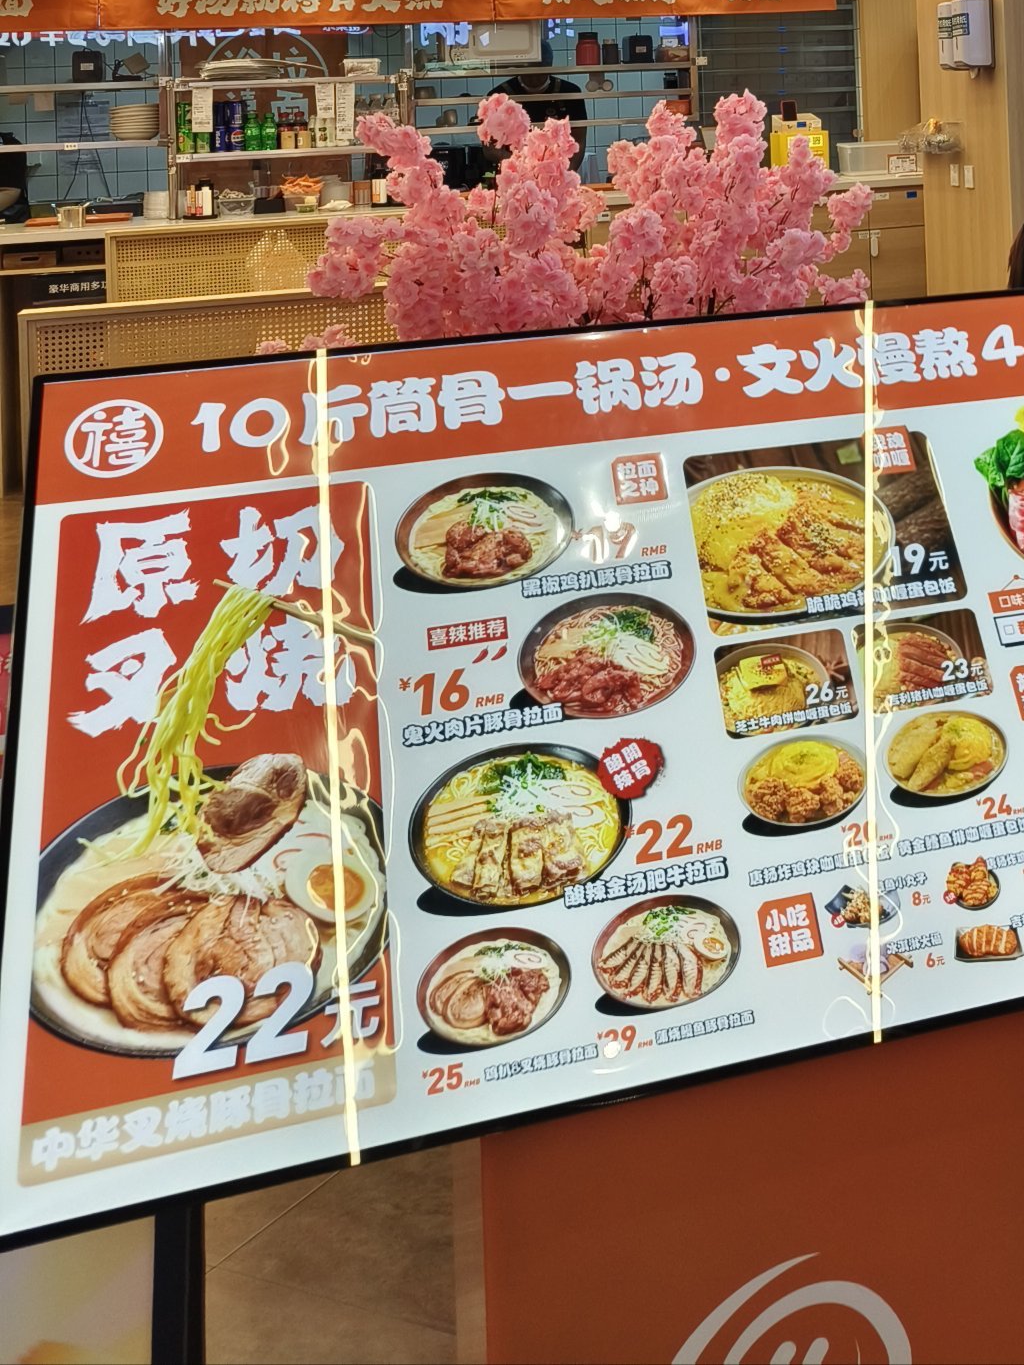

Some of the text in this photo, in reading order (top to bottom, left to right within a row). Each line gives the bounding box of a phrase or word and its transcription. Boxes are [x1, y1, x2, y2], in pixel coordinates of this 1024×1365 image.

[641, 545, 667, 557] RMB
[522, 560, 672, 598] 黑椒鸡扒豚骨拉面
[429, 619, 506, 646] 喜辣推荐
[941, 658, 984, 682] 23元
[475, 693, 504, 708] RMB
[805, 684, 848, 706] 26元
[402, 703, 565, 747] 鬼火肉片豚骨拉面
[696, 839, 722, 855] RMB
[563, 856, 729, 909] 酸辣金汤肥牛拉面
[912, 891, 931, 906] 8元
[765, 903, 809, 933] 小吃
[768, 929, 815, 958] 甜品
[926, 952, 945, 967] 6元
